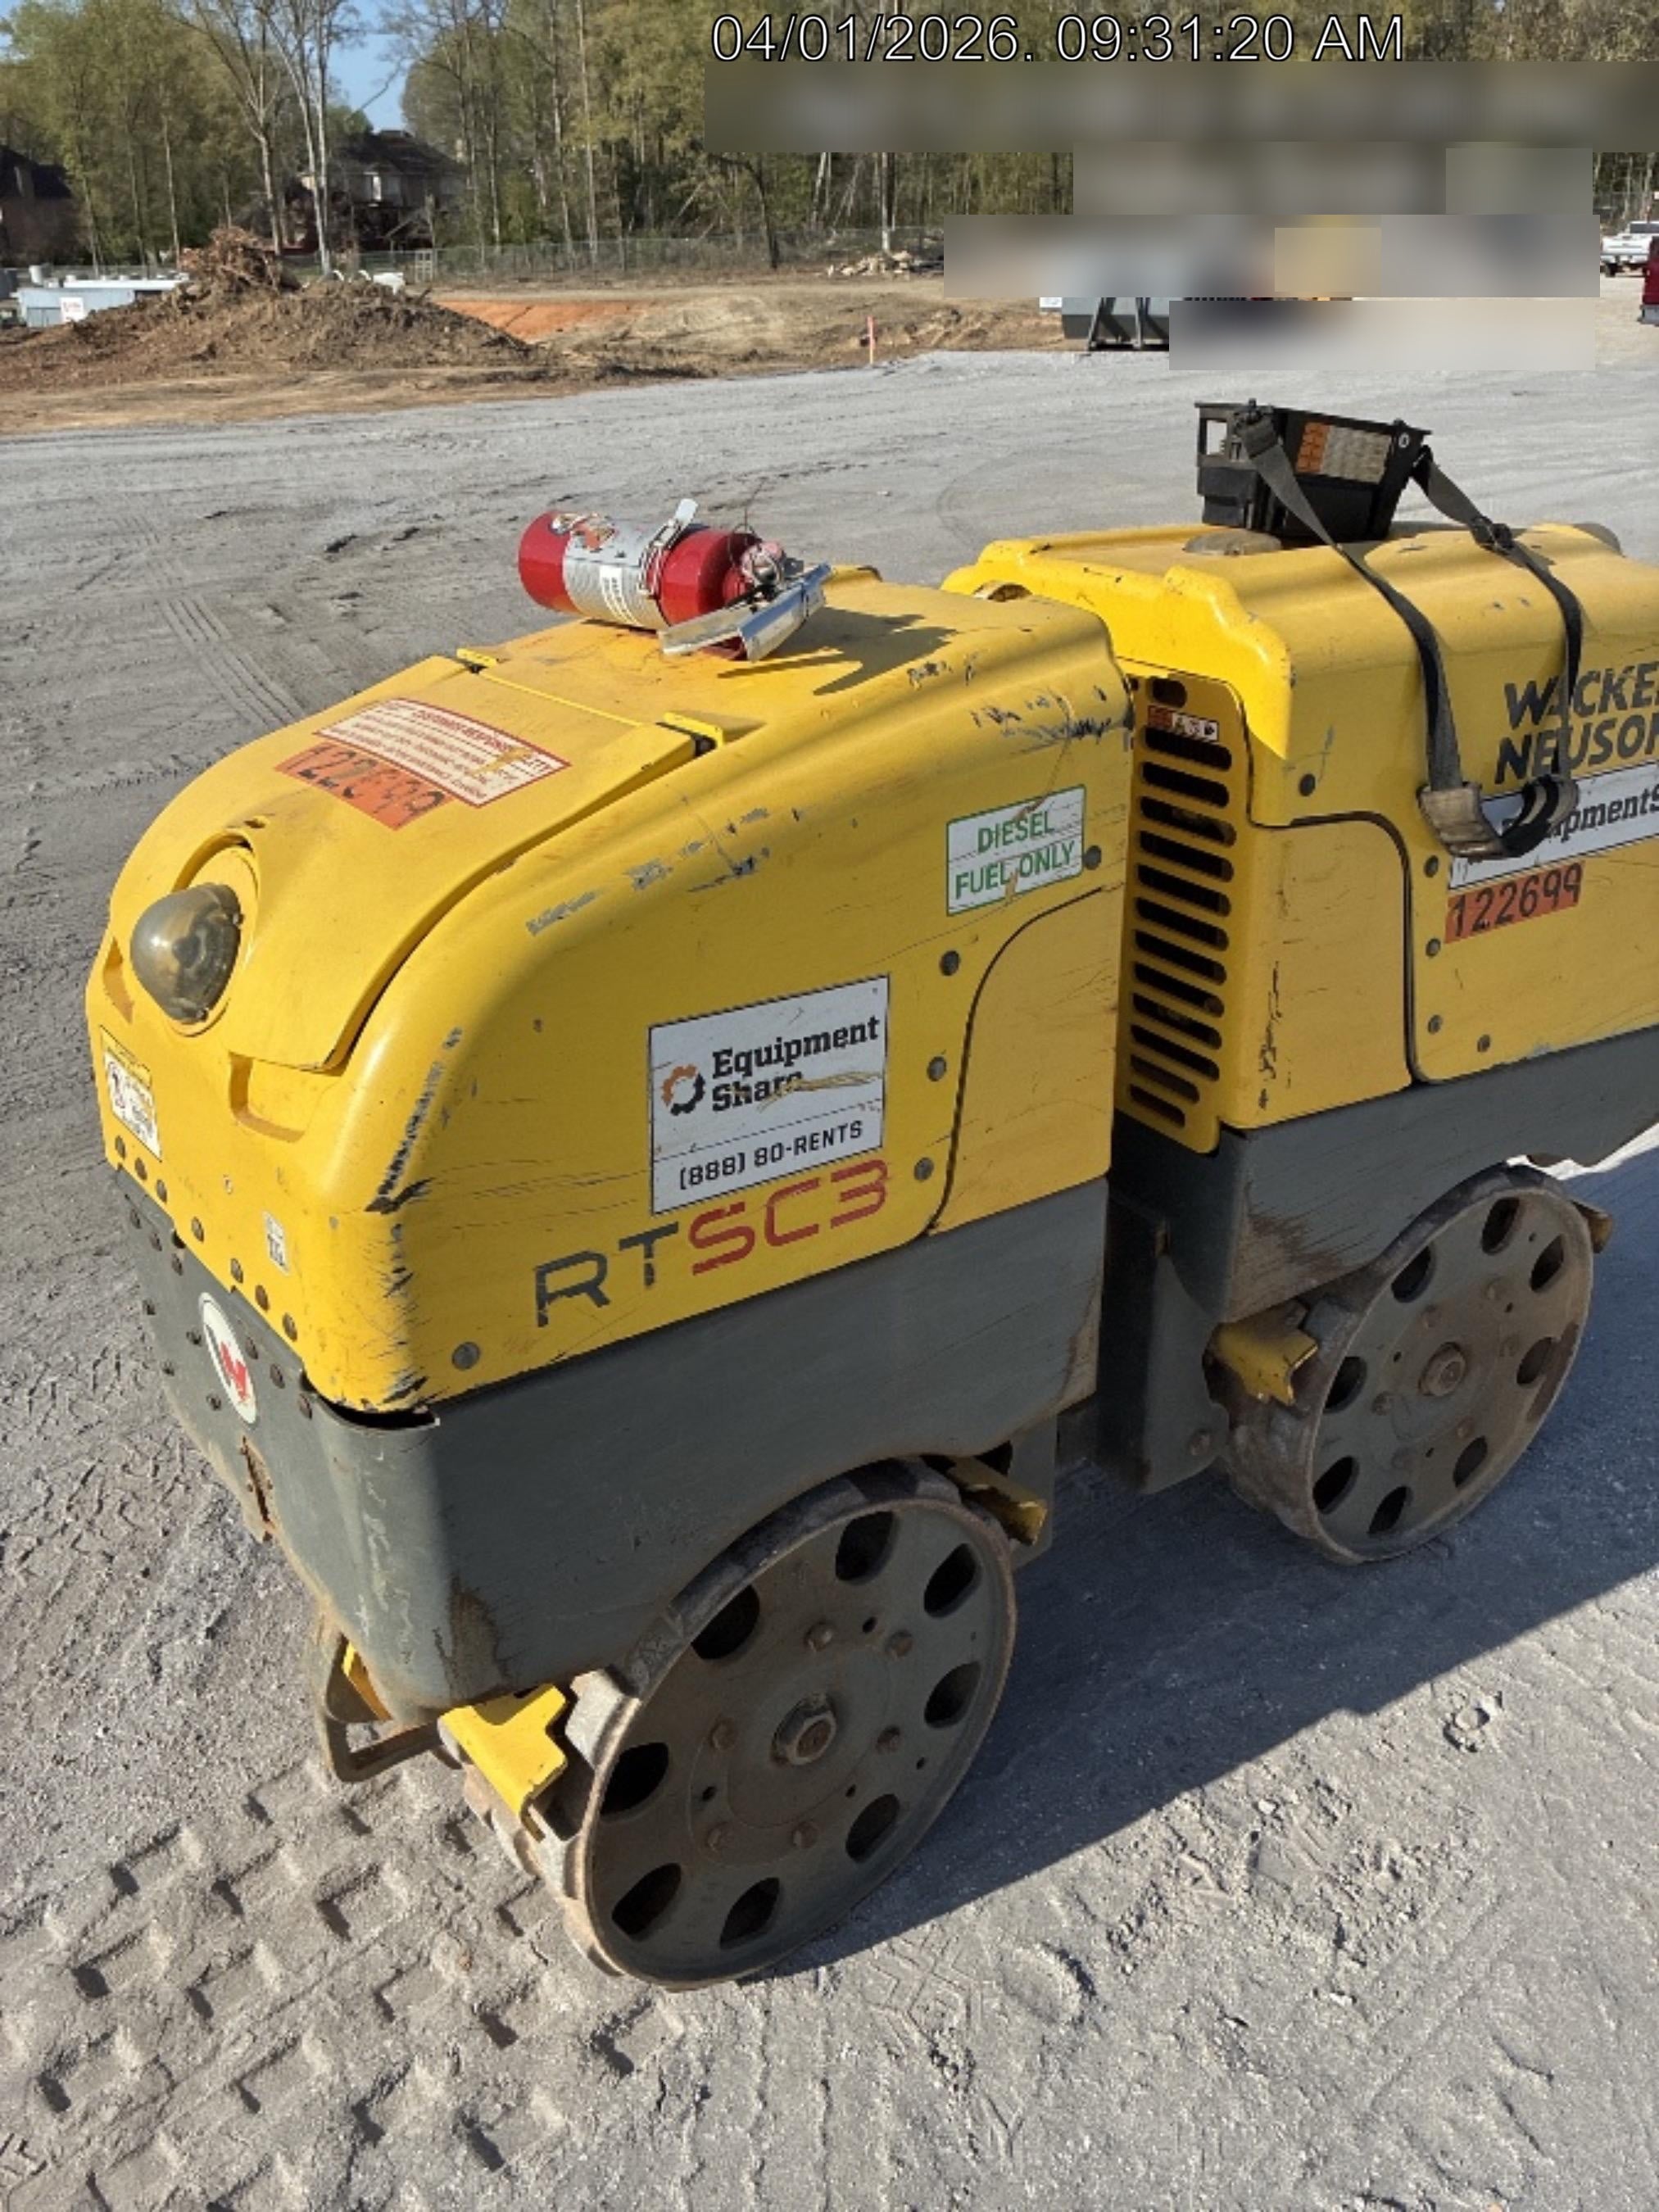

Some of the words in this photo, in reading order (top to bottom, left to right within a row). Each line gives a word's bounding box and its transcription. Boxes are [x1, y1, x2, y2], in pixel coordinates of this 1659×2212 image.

[977, 810, 1055, 854] DIESEL
[955, 861, 1011, 900] FUEL
[1018, 841, 1075, 878] ONLY
[1453, 862, 1583, 937] 122699
[712, 1015, 880, 1080] Equipment
[679, 1152, 746, 1190] (888)
[754, 1120, 863, 1167] 80-RENTS
